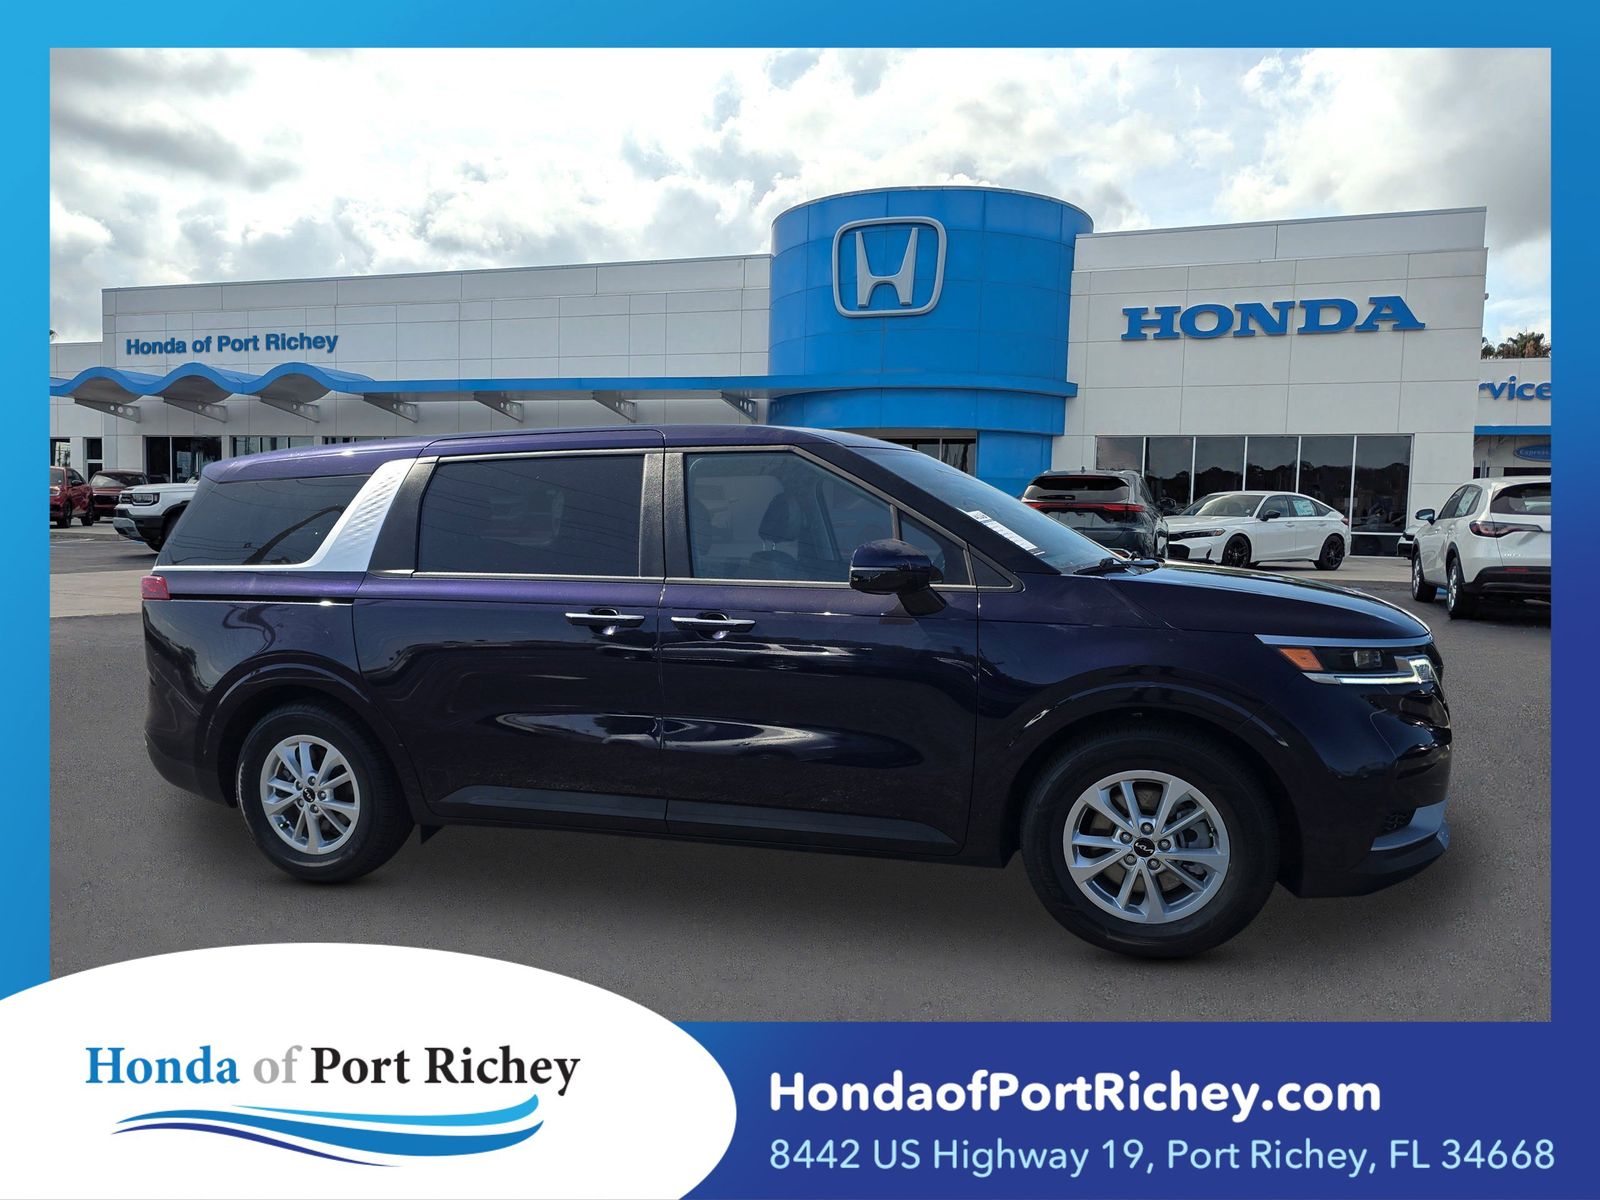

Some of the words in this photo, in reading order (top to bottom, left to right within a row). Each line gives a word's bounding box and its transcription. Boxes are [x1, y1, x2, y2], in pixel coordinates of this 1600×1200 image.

[1120, 295, 1425, 341] HONDA
[125, 338, 187, 355] Honda
[191, 335, 213, 353] of
[217, 335, 260, 352] Port
[265, 332, 339, 353] Richey
